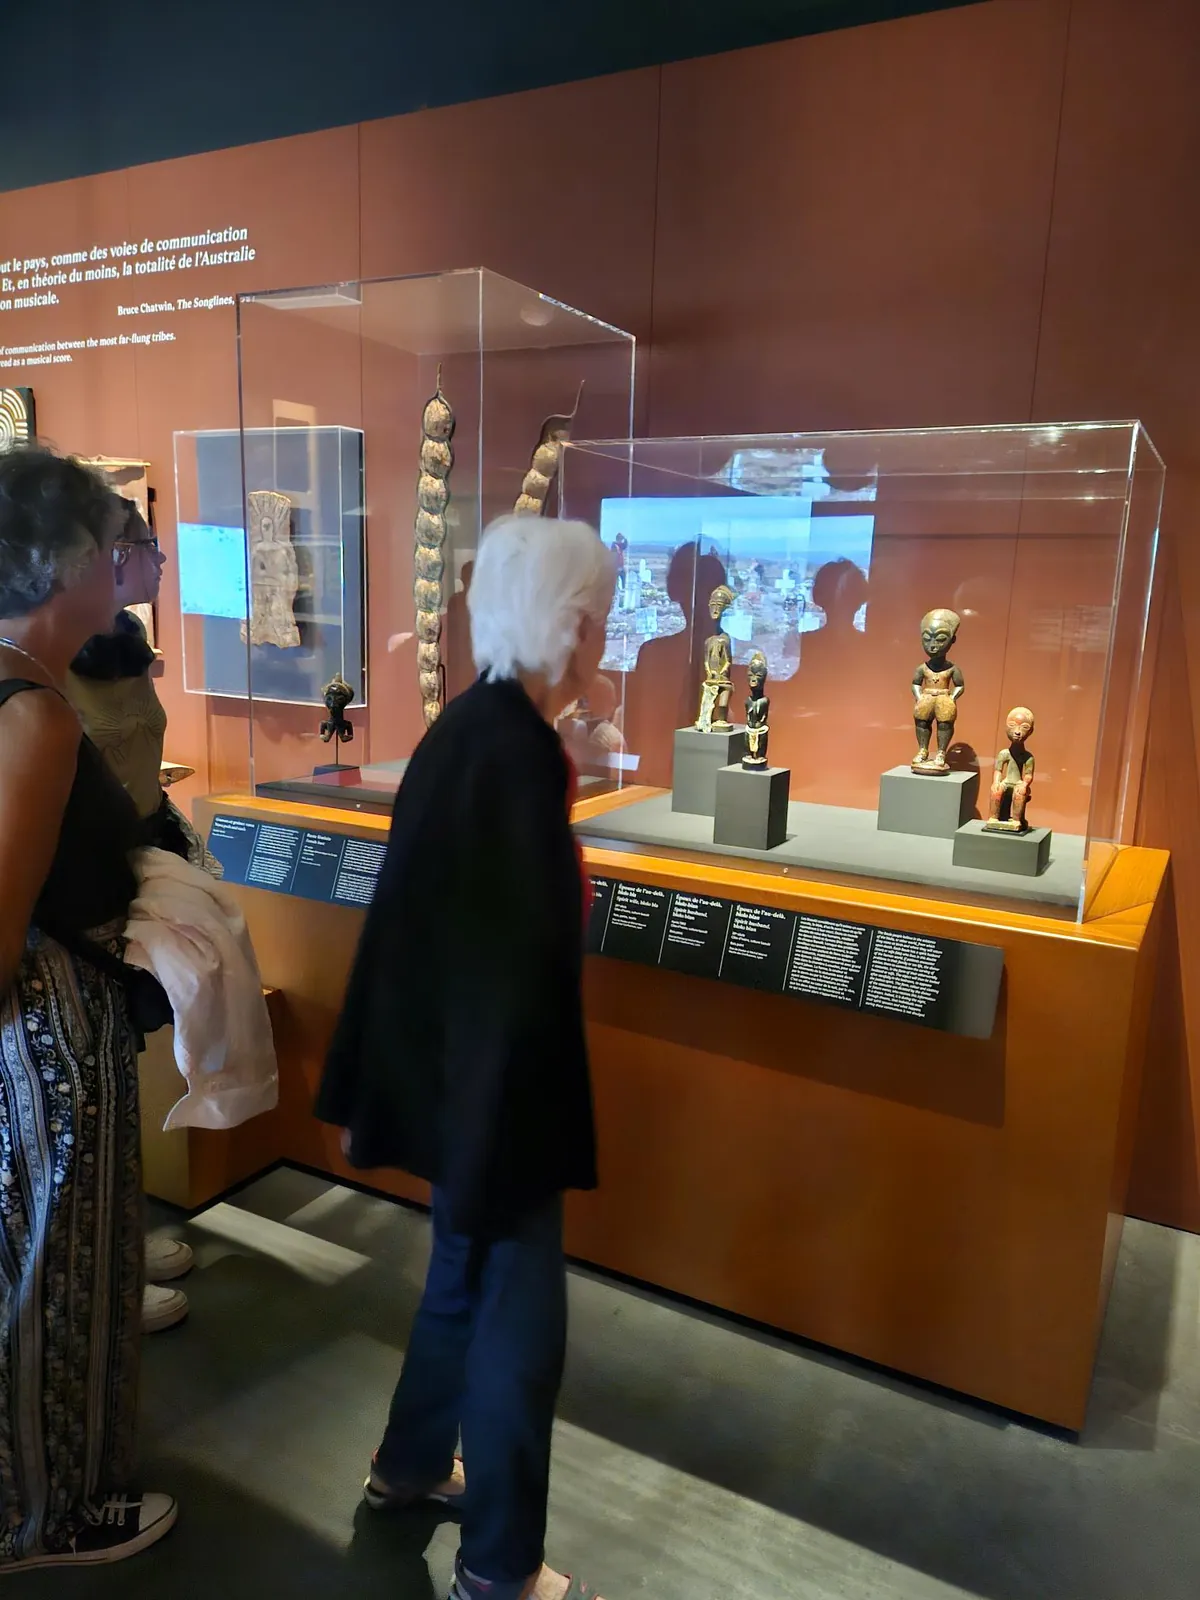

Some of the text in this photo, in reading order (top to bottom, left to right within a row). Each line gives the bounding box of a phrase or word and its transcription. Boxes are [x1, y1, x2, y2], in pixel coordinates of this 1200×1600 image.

[13, 258, 21, 272] le
[23, 257, 49, 274] pays,
[51, 250, 88, 266] comme
[90, 246, 108, 261] des
[110, 241, 138, 258] voies
[140, 238, 154, 254] de
[156, 226, 248, 251] communication
[2, 278, 15, 292] Et,
[17, 277, 29, 290] en
[31, 270, 67, 288] théorie
[69, 268, 82, 283] du
[85, 264, 120, 281] moins,
[122, 261, 132, 276] la
[135, 255, 175, 275] totalité
[178, 253, 192, 269] de
[14, 290, 60, 309] musicale.
[117, 305, 139, 316] Bruce
[140, 301, 175, 313] Chatwin,
[177, 298, 192, 310] The
[193, 295, 235, 309] Songlines,
[5, 341, 56, 355] communication
[57, 340, 86, 350] between
[86, 337, 98, 348] the
[99, 336, 117, 347] most
[118, 332, 151, 346] far-flung
[152, 331, 176, 343] tribes.
[26, 353, 52, 365] musical
[53, 354, 73, 363] score.
